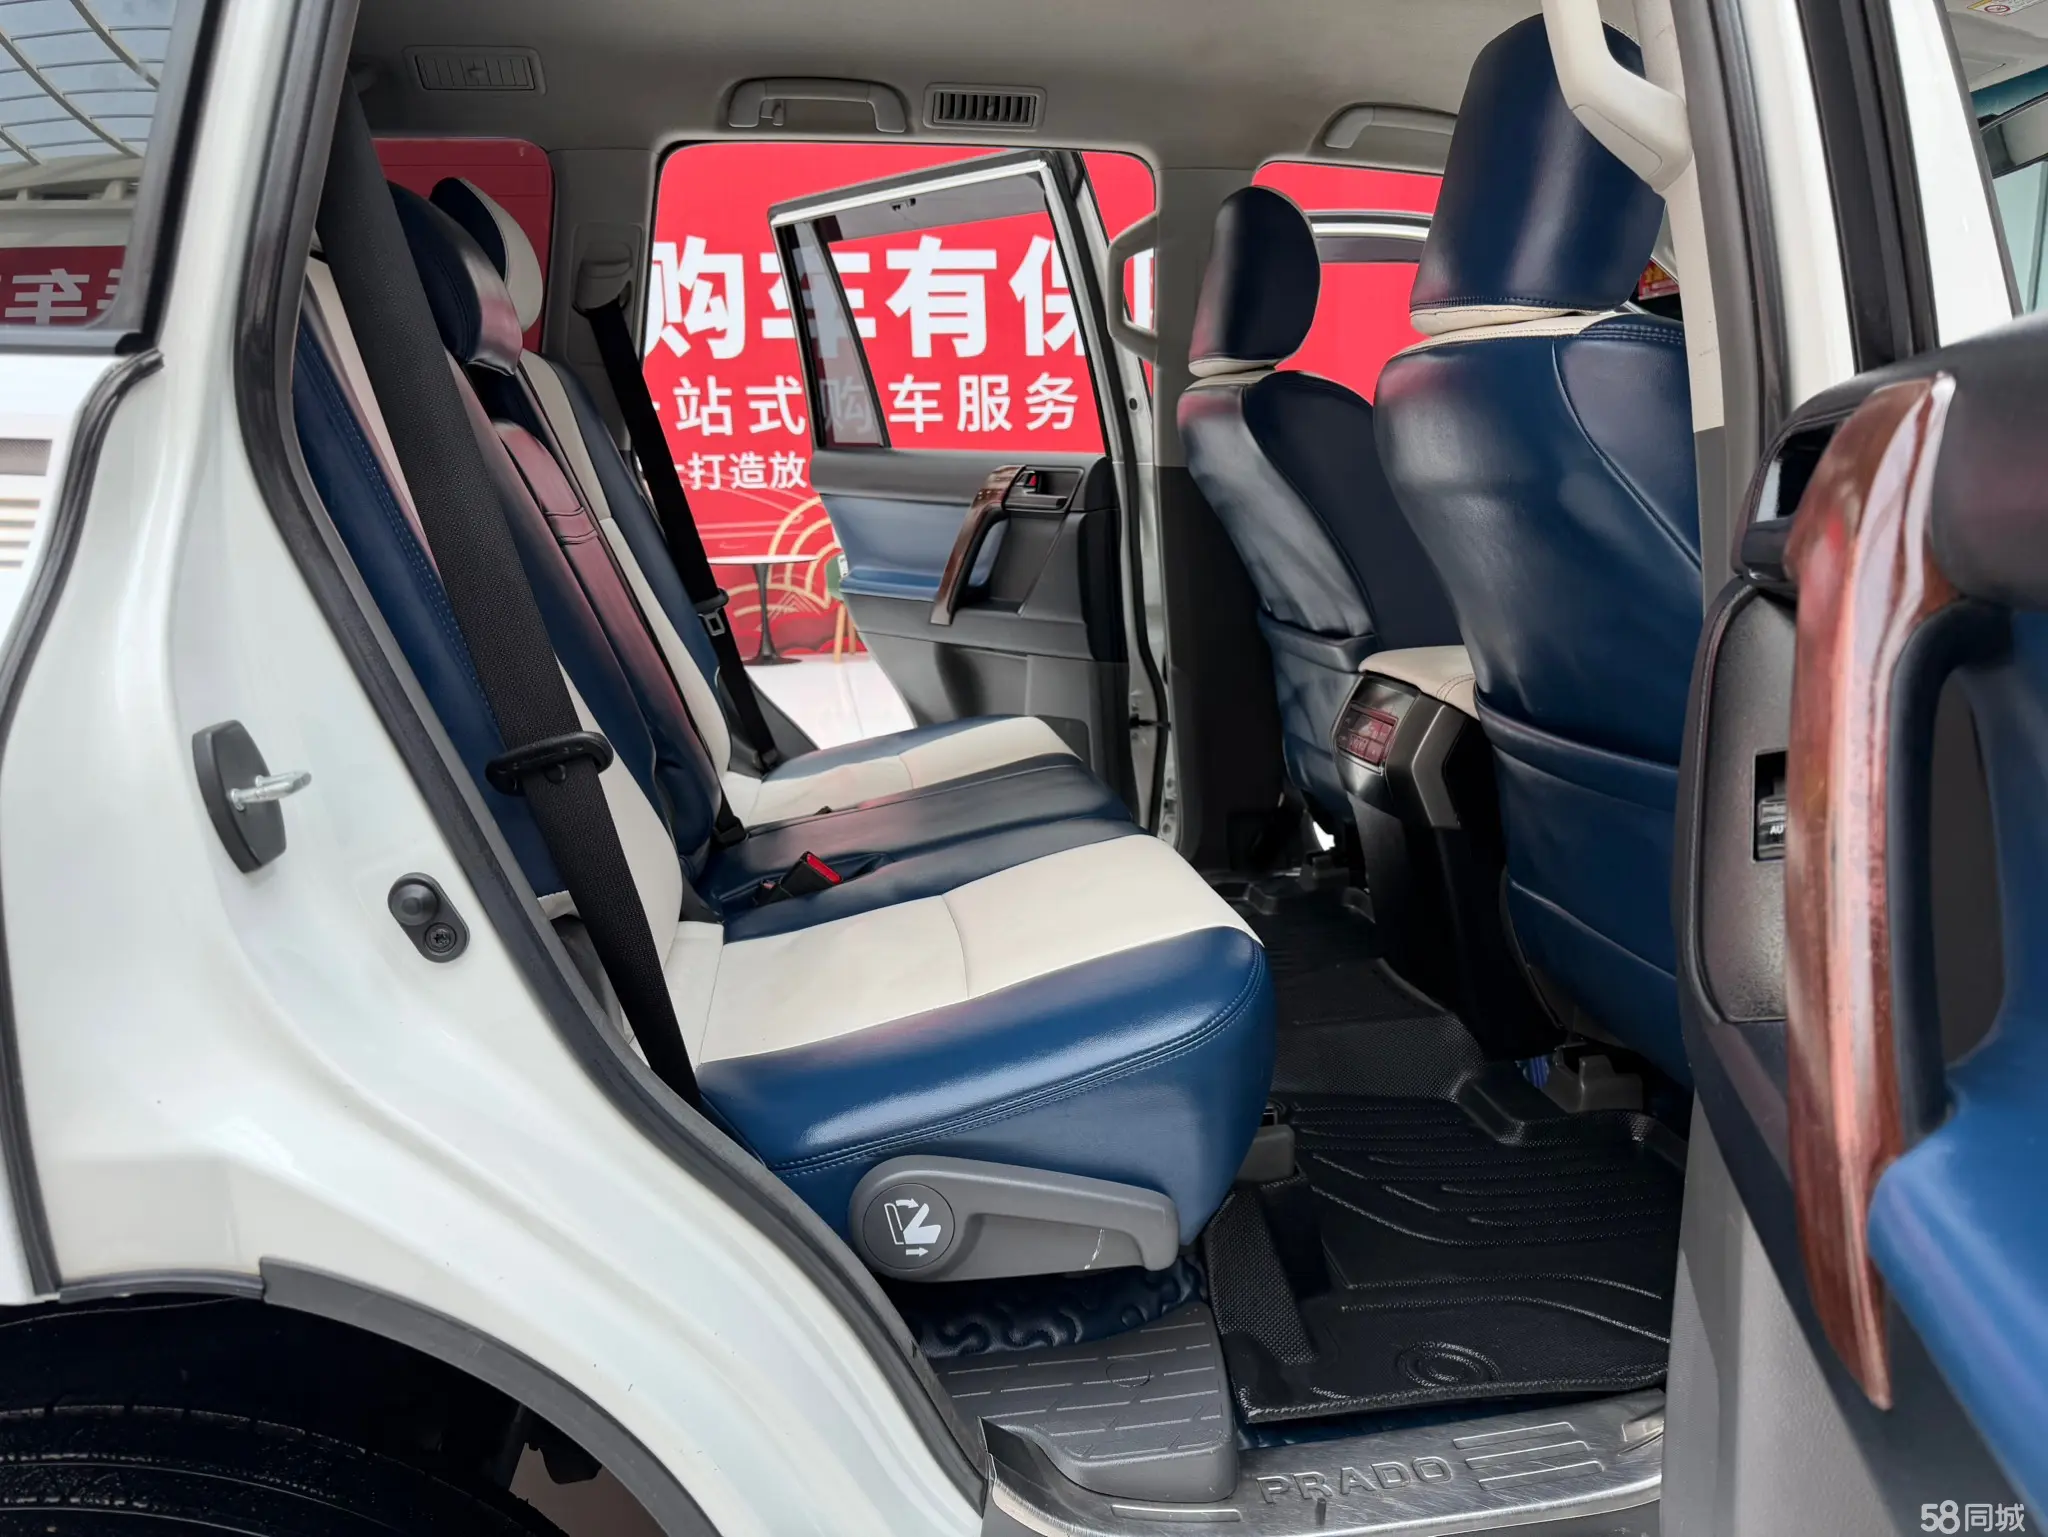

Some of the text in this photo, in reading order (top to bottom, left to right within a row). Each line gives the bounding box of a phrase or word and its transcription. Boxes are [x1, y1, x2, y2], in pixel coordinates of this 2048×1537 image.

[644, 235, 1154, 360] 购车有保
[653, 373, 1079, 436] 站式购车服务
[676, 451, 807, 490] 打造放
[1256, 1456, 1453, 1503] PRADO
